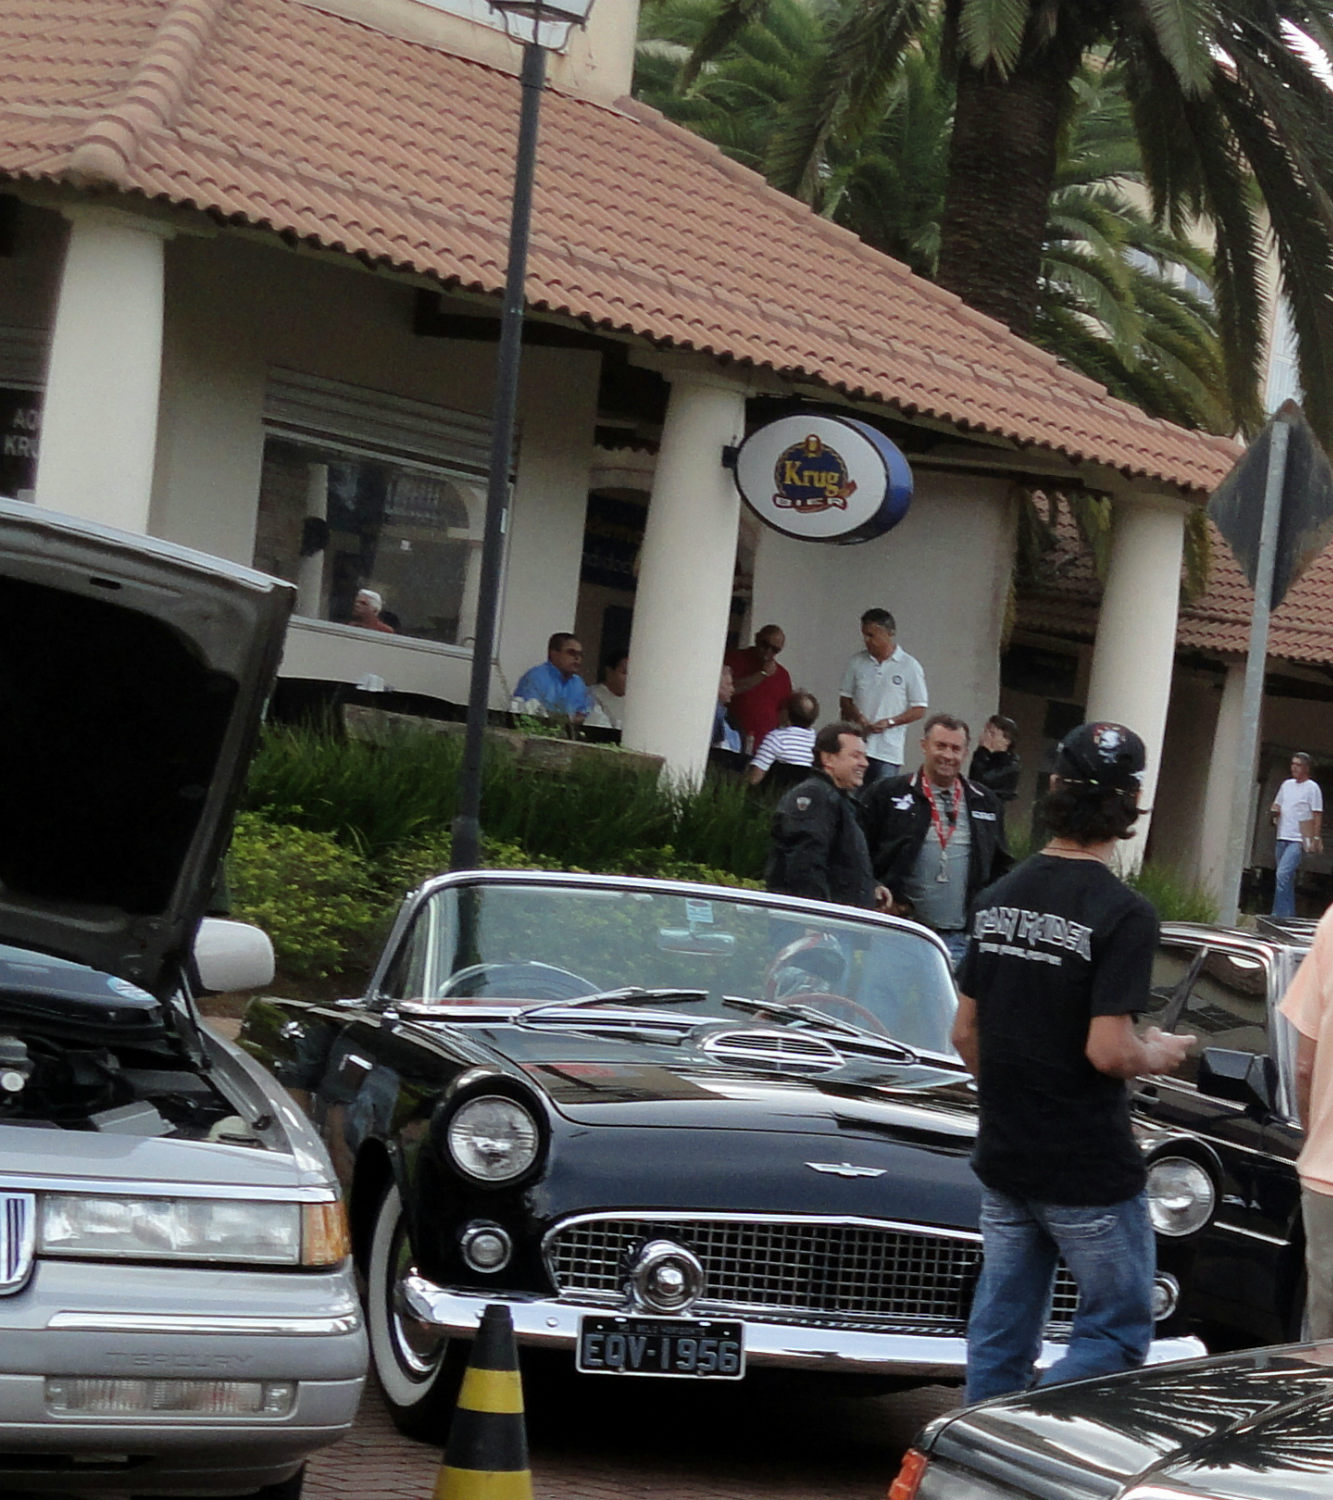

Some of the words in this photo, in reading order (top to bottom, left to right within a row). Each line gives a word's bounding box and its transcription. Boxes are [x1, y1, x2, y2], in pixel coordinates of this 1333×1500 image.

[784, 460, 840, 497] Krug
[775, 496, 844, 507] BIER
[584, 1333, 739, 1373] EQV-1956
